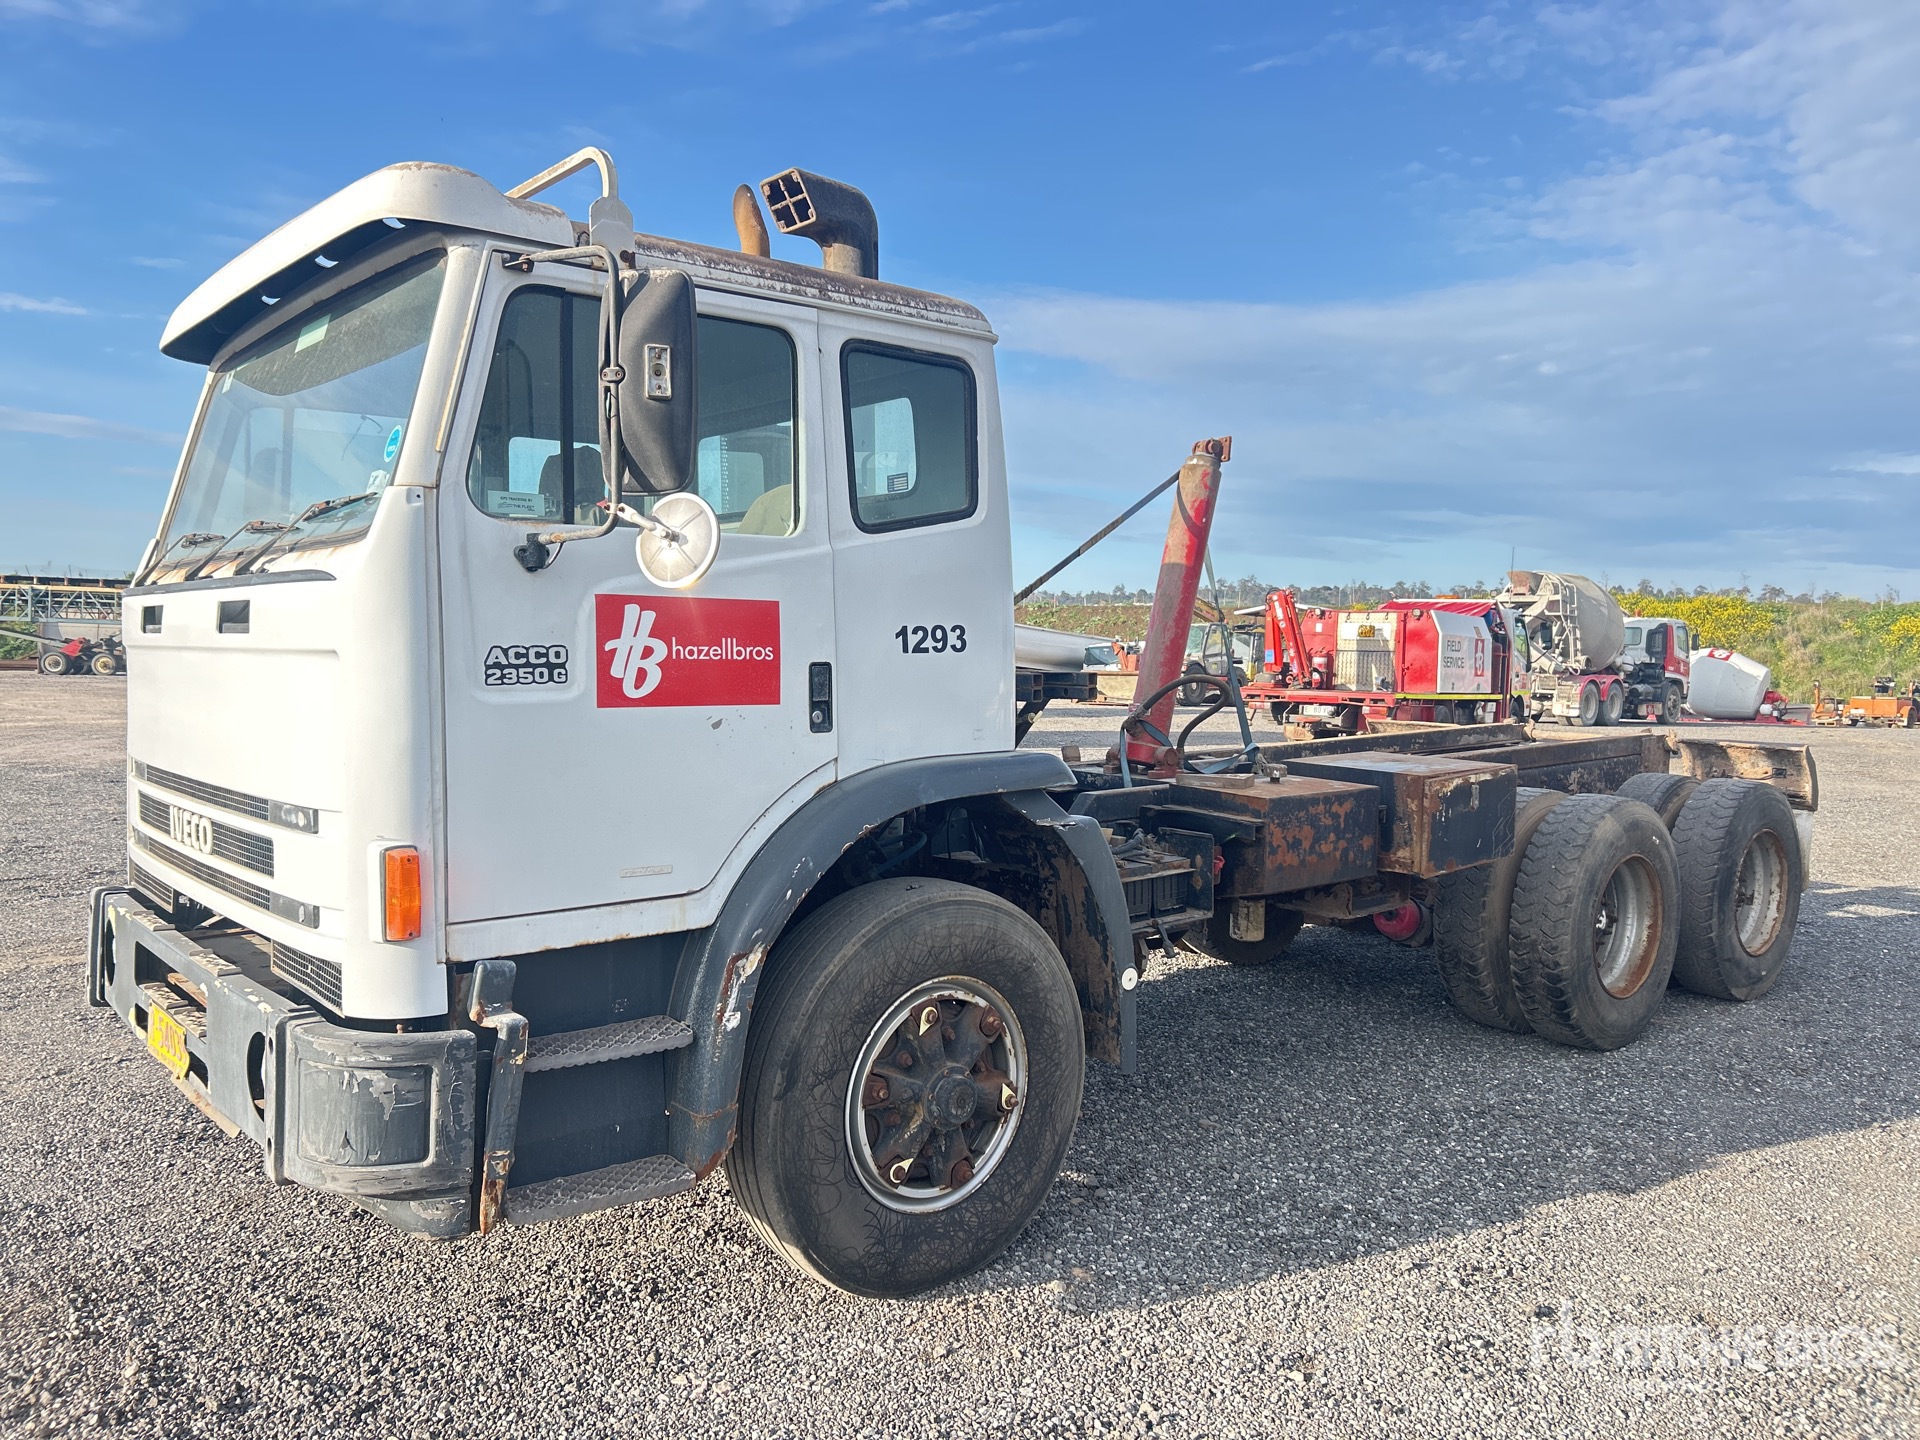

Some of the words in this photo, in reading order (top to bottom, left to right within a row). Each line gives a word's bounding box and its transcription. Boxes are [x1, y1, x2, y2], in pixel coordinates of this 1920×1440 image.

[671, 637, 774, 660] hazellbros
[895, 624, 967, 654] 1293
[1446, 639, 1462, 653] FIELD
[485, 646, 567, 665] ACCO
[1443, 655, 1465, 669] SERVICE
[486, 667, 549, 685] 2350
[553, 668, 567, 683] G
[169, 804, 213, 855] IVECO
